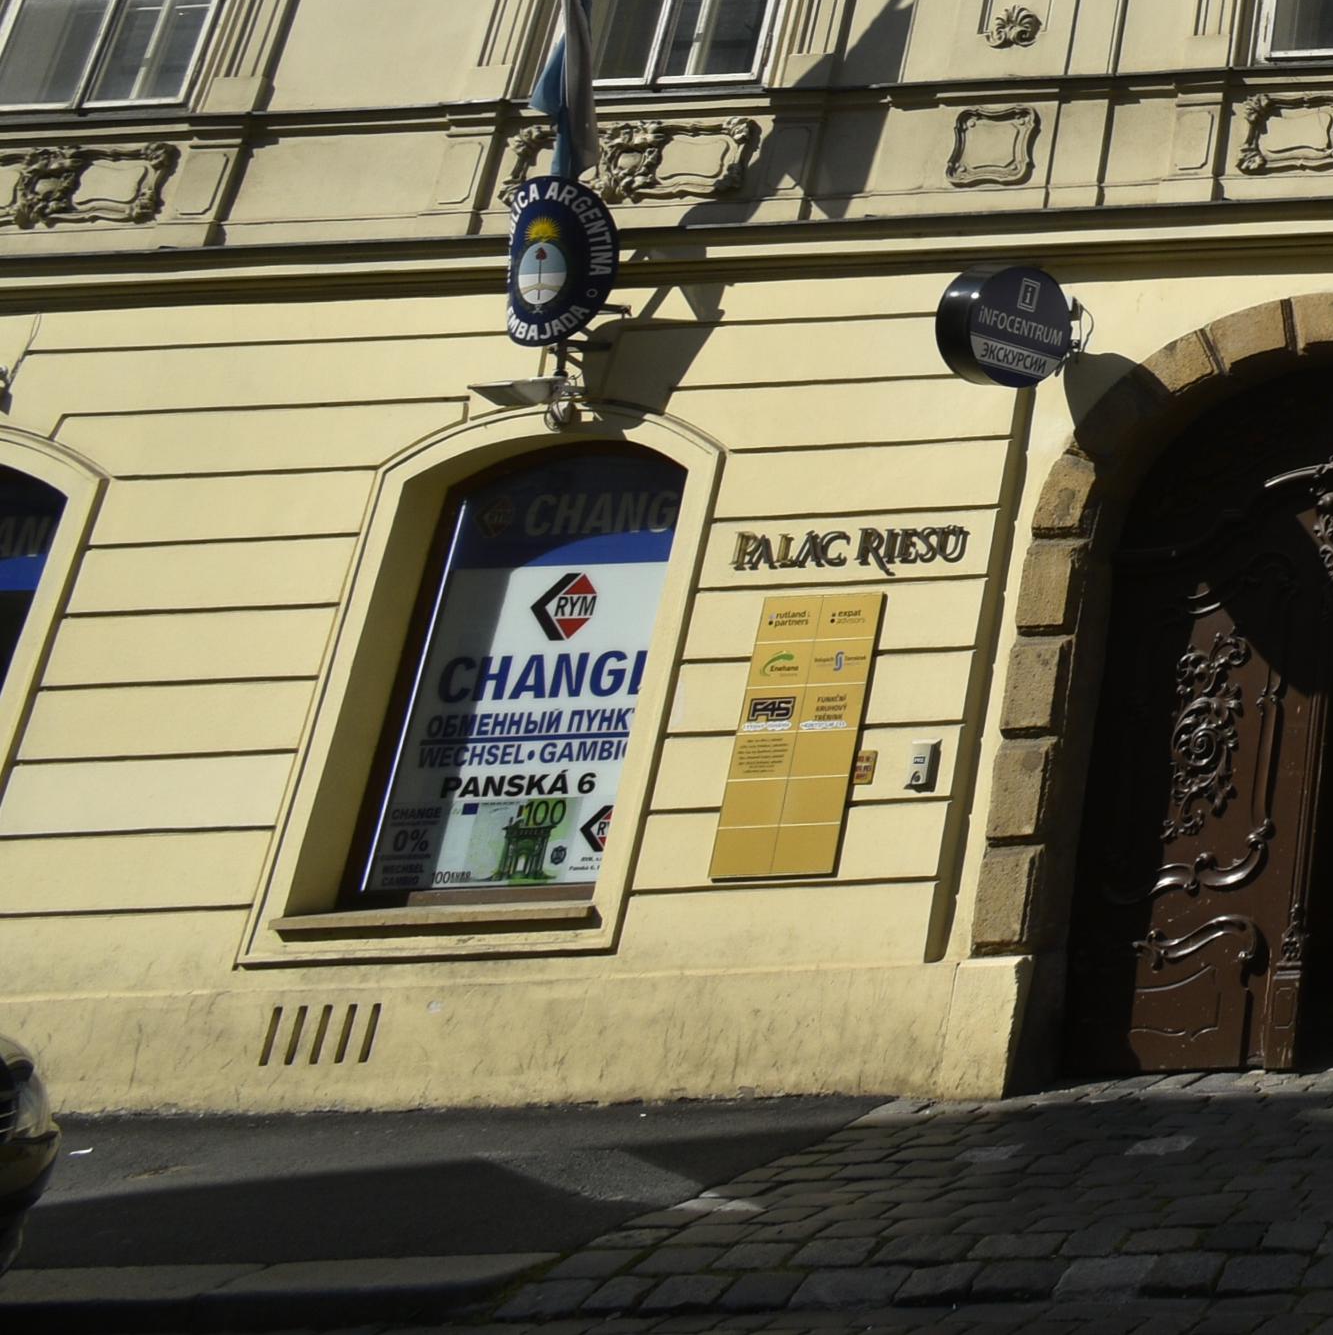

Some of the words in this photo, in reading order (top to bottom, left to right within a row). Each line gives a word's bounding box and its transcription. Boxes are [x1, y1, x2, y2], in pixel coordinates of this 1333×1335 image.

[545, 181, 613, 276] ARGENTINA
[507, 304, 591, 341] EMBAJADA
[980, 342, 1048, 375] ЭКСКУРСИИ
[554, 595, 597, 617] RYM
[775, 610, 806, 619] rutland
[838, 610, 861, 618] expat
[774, 618, 808, 628] partners
[427, 708, 564, 738] ОБМЕННЫЙ
[566, 708, 635, 732] ПУНК
[440, 769, 569, 799] PANSKÁ
[577, 772, 597, 794] 6
[391, 806, 442, 821] CHANGE
[524, 800, 567, 826] 100
[393, 828, 429, 853] 0%
[431, 871, 451, 885] 100
